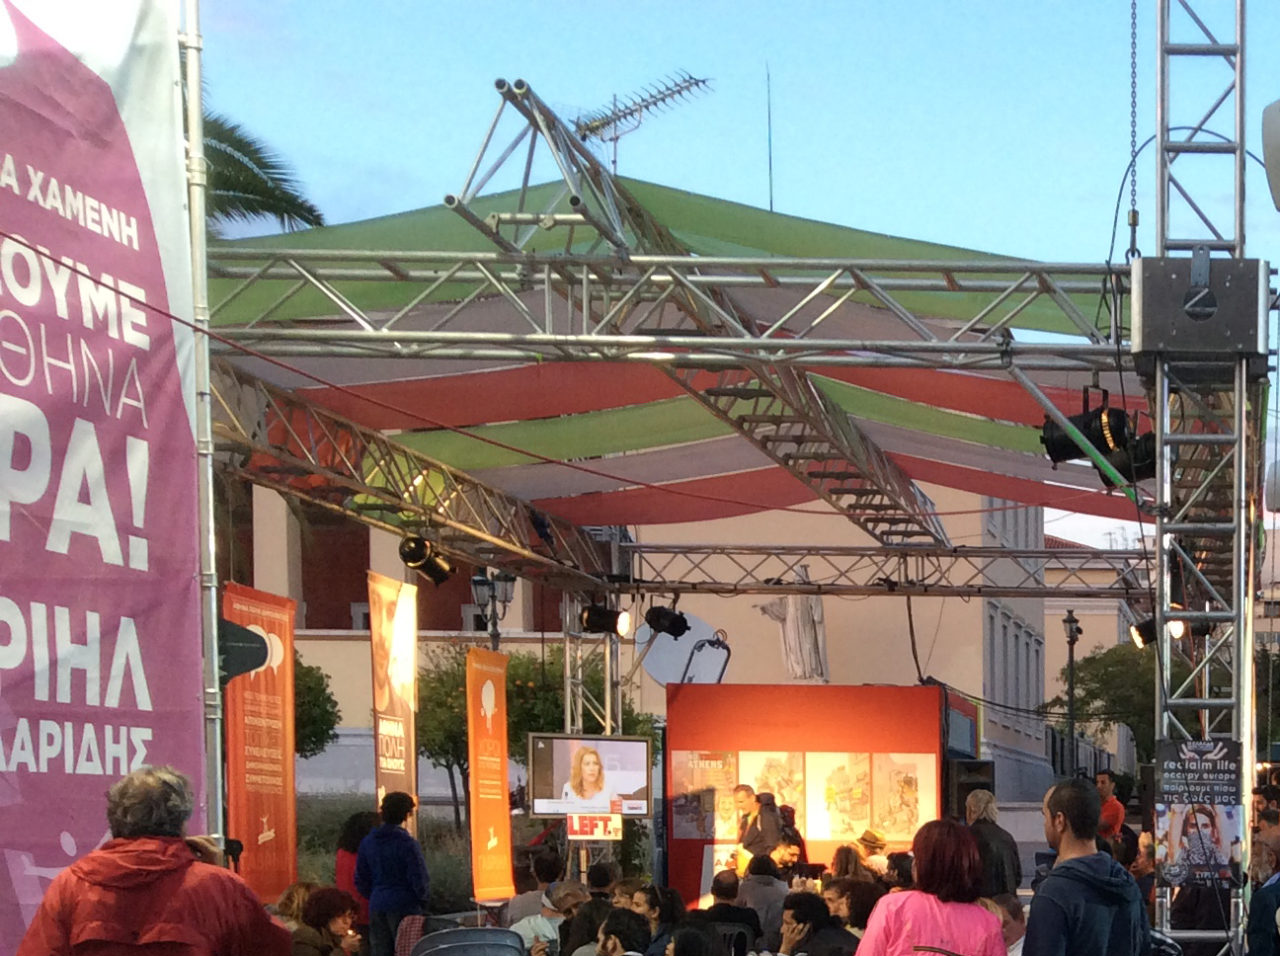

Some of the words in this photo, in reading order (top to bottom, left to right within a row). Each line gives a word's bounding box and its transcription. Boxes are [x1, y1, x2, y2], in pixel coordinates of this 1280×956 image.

[26, 164, 139, 251] ΧΑΜΕΝΗ
[0, 233, 150, 350] ΟΥΜΕ
[0, 717, 153, 776] ΑΡΙΔΗΣ
[379, 734, 406, 758] ΠΟΛΗ
[1163, 760, 1213, 770] reclaim
[1216, 760, 1237, 770] life
[1202, 772, 1236, 781] europe
[1163, 794, 1180, 803] τις
[1214, 794, 1237, 804] μας
